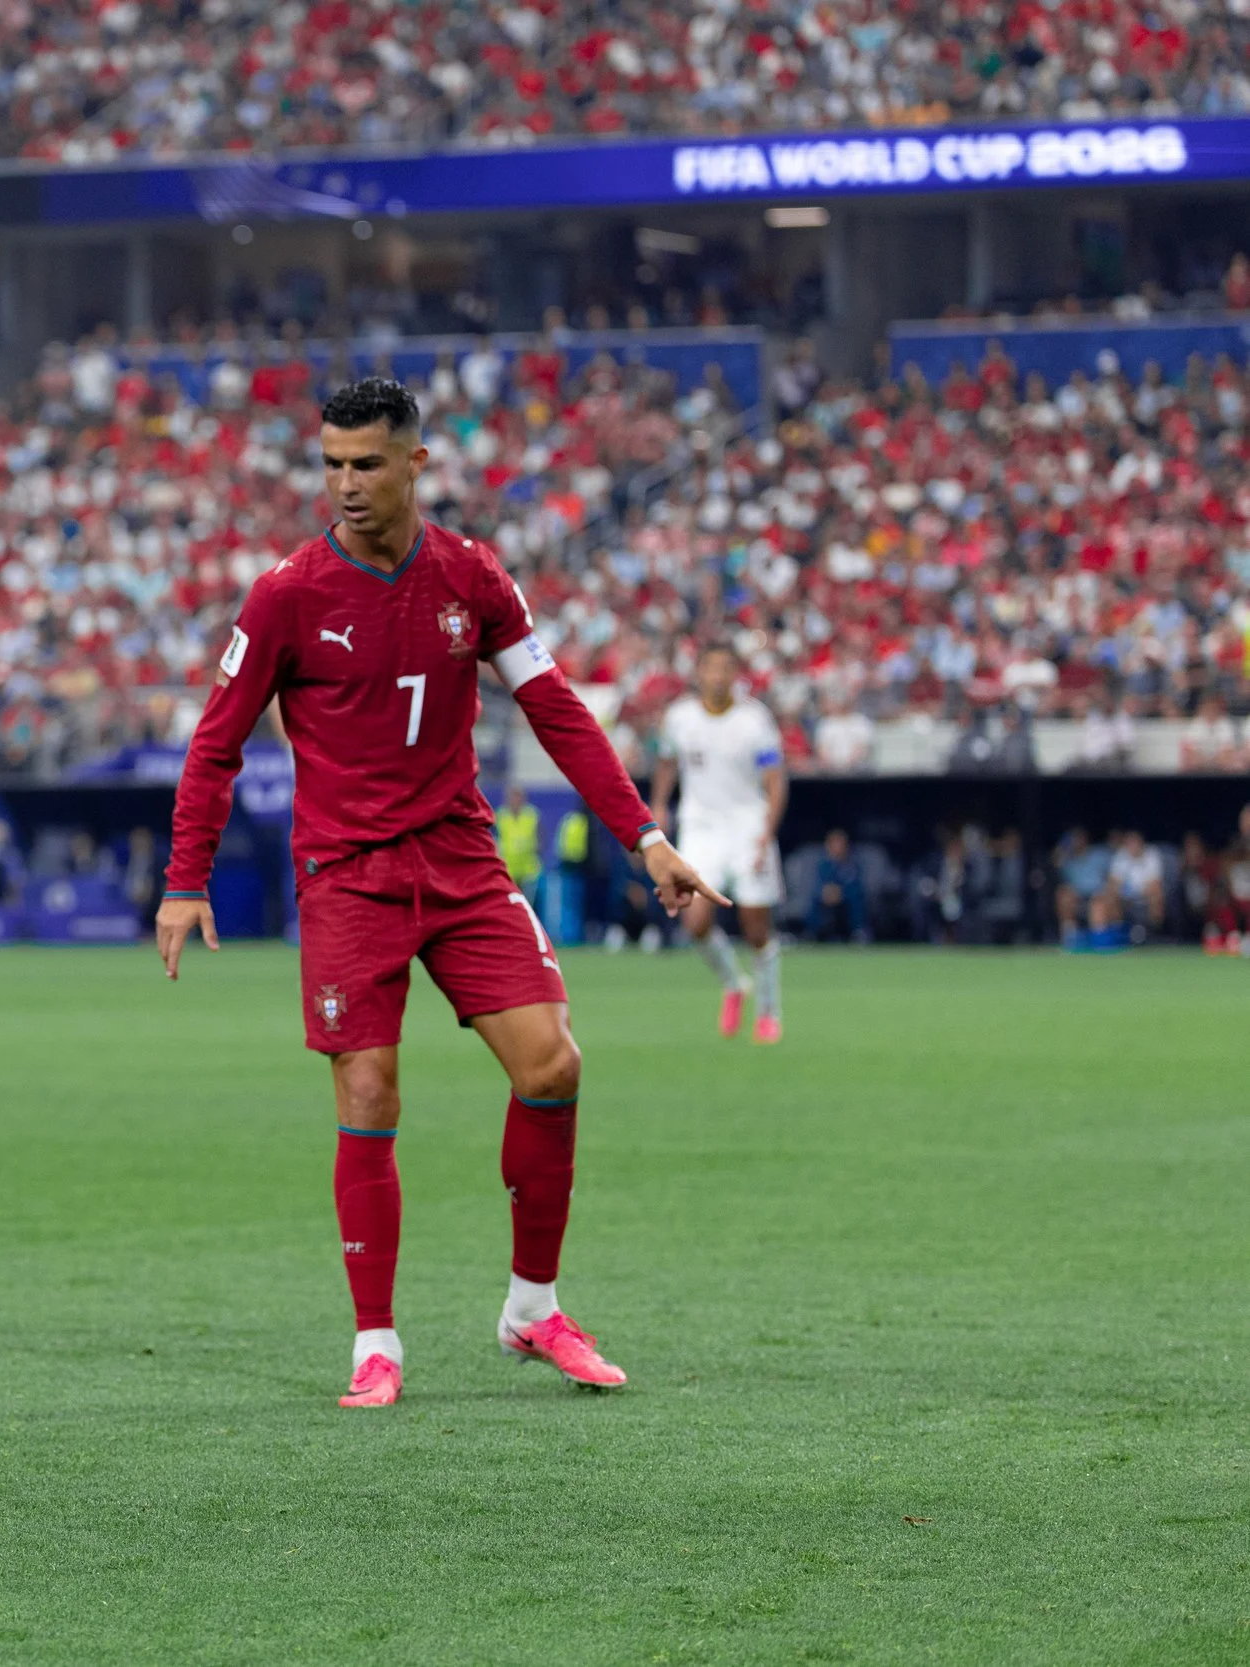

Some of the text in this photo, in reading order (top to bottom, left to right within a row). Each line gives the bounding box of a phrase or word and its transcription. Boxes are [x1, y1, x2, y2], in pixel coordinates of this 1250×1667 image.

[673, 126, 1187, 192] FIFA WORLD CUP 2026
[396, 673, 426, 747] 7
